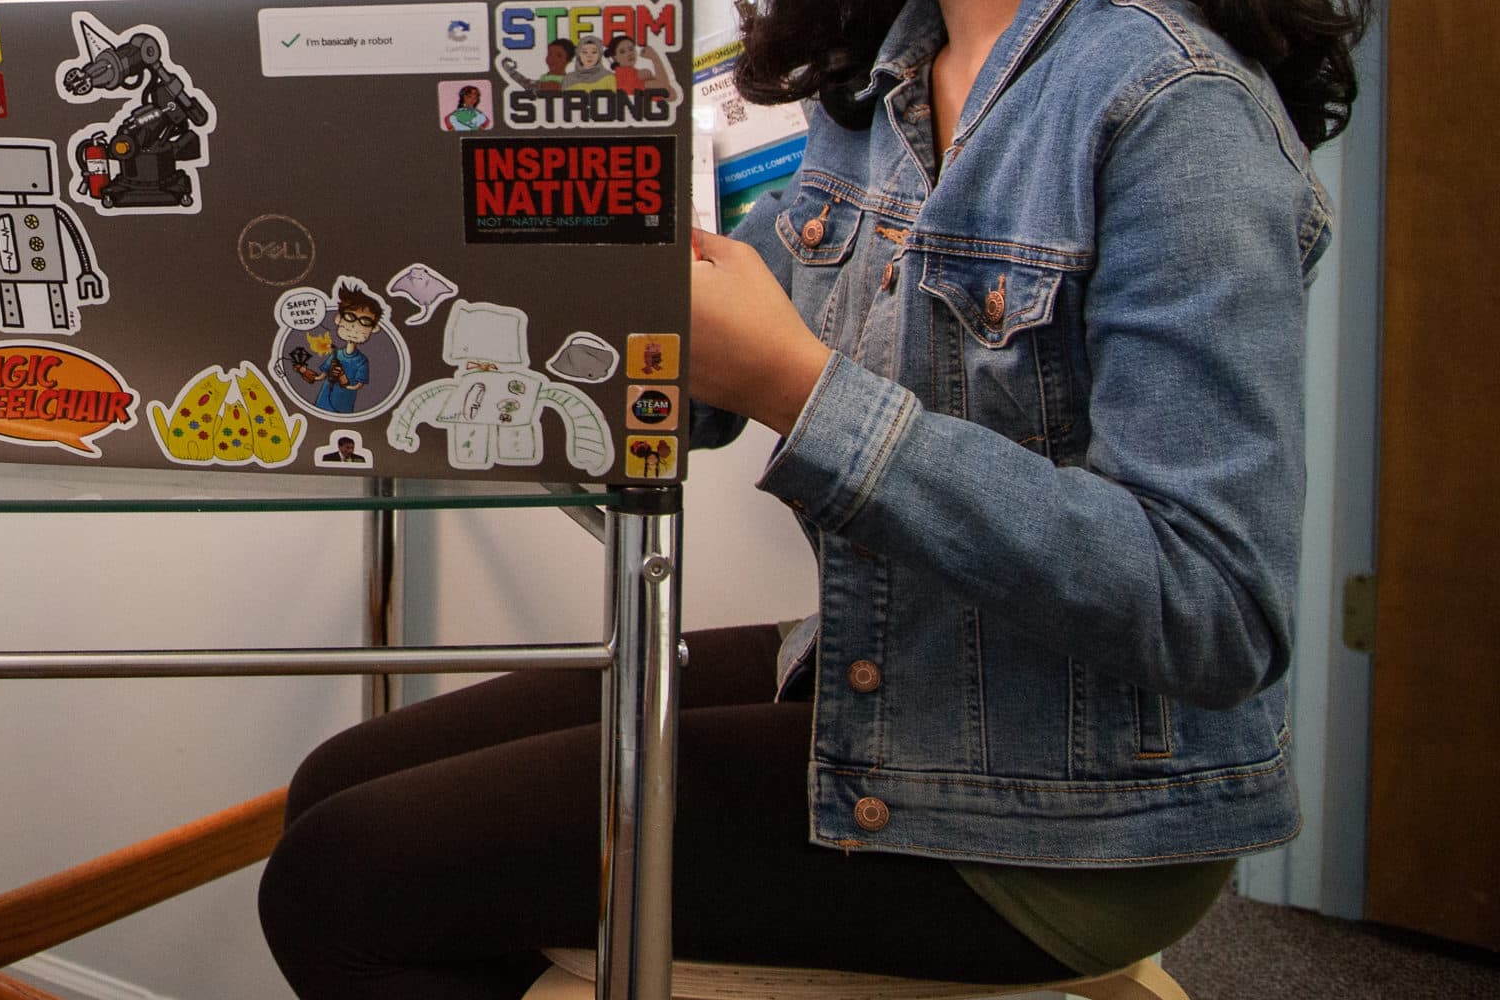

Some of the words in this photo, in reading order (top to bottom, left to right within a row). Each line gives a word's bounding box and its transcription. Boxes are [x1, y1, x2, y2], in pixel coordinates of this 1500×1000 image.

[502, 4, 676, 50] STEAM
[306, 38, 320, 47] I'm
[321, 37, 358, 48] basically
[368, 36, 393, 46] robot
[510, 88, 670, 123] STRONG
[474, 146, 662, 181] INSPIRED
[724, 163, 765, 184] ROBOTICS
[476, 179, 662, 216] NATIVES
[477, 217, 502, 227] NOT
[248, 241, 308, 259] DELL
[286, 299, 318, 310] SAFETY
[294, 318, 316, 326] KIDS
[635, 400, 669, 409] STEAM
